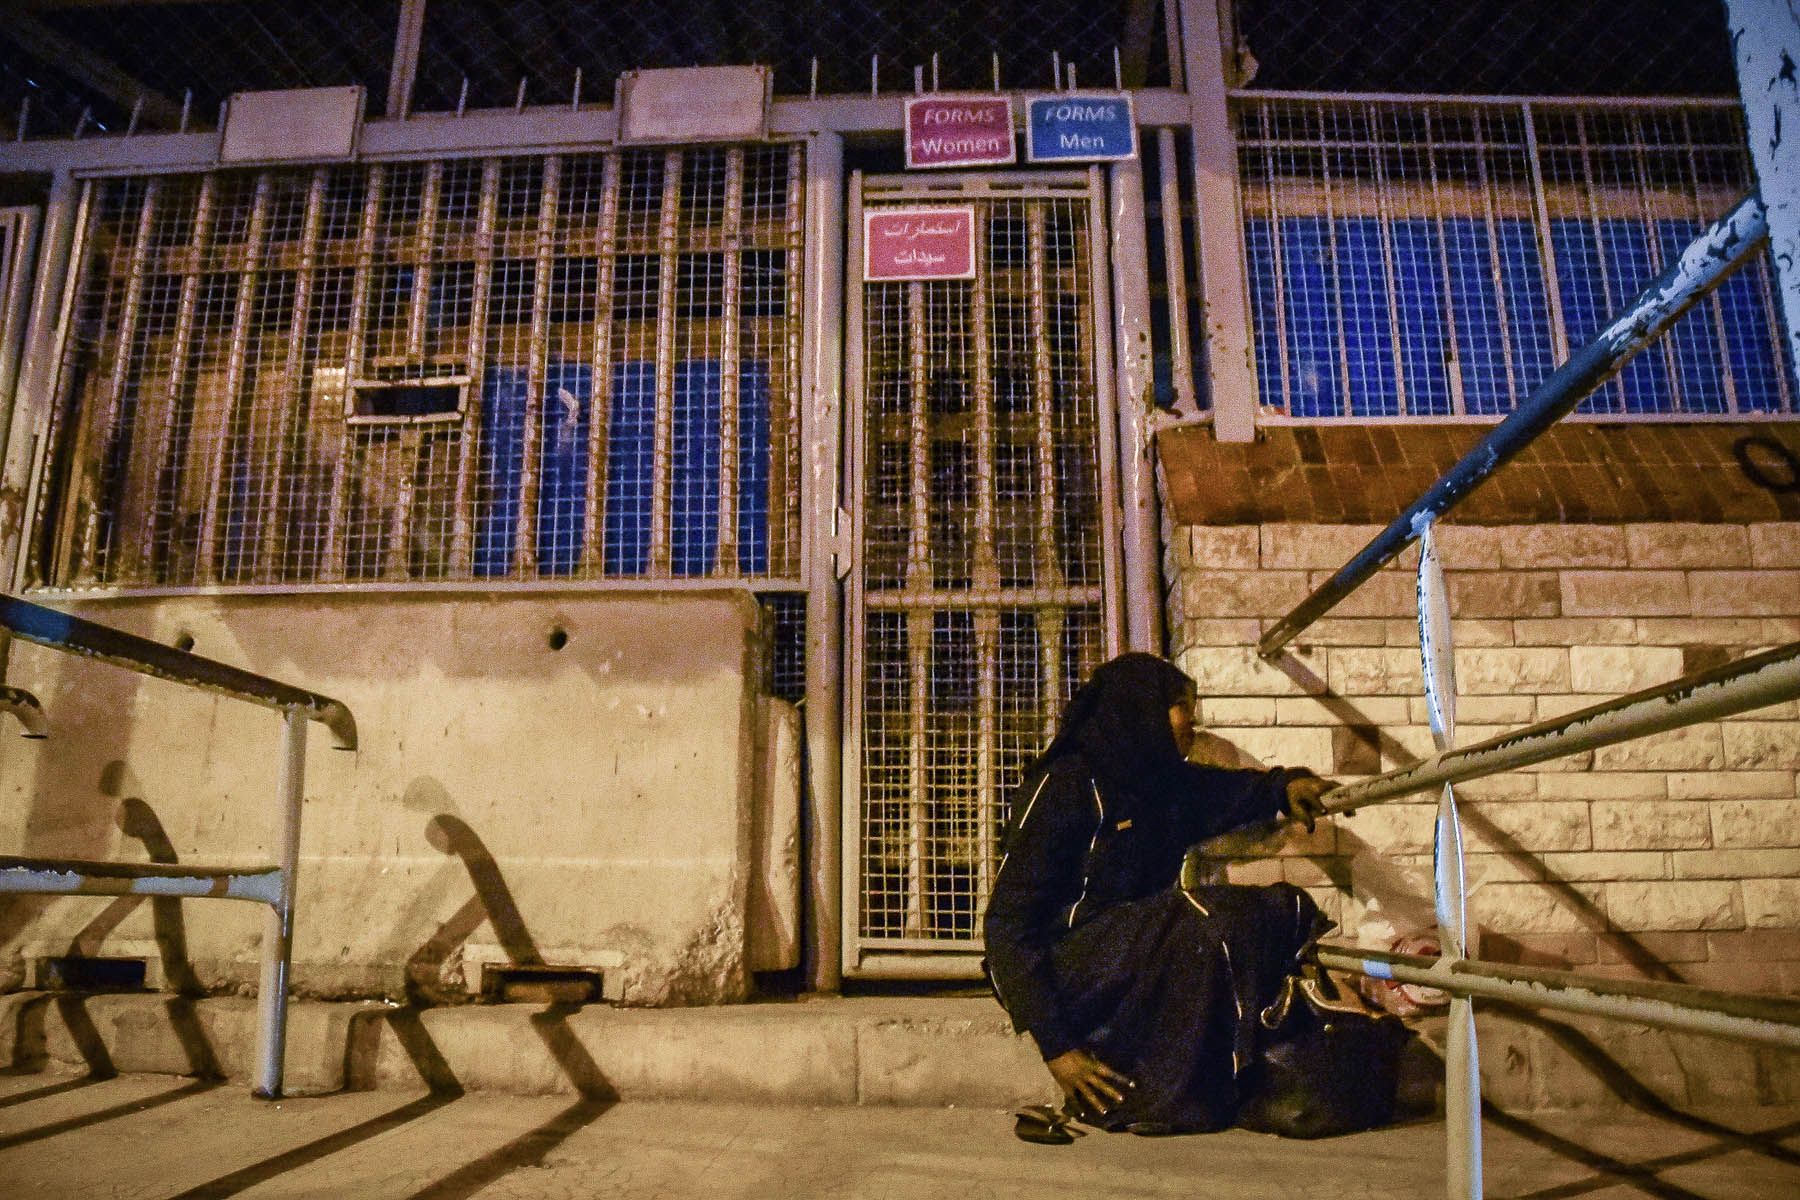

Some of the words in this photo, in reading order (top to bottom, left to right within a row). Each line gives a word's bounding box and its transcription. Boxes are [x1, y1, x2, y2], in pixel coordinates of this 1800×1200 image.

[923, 108, 996, 125] FORMS
[1045, 105, 1117, 122] FORMS
[921, 138, 1000, 156] Women
[1060, 132, 1105, 150] Men
